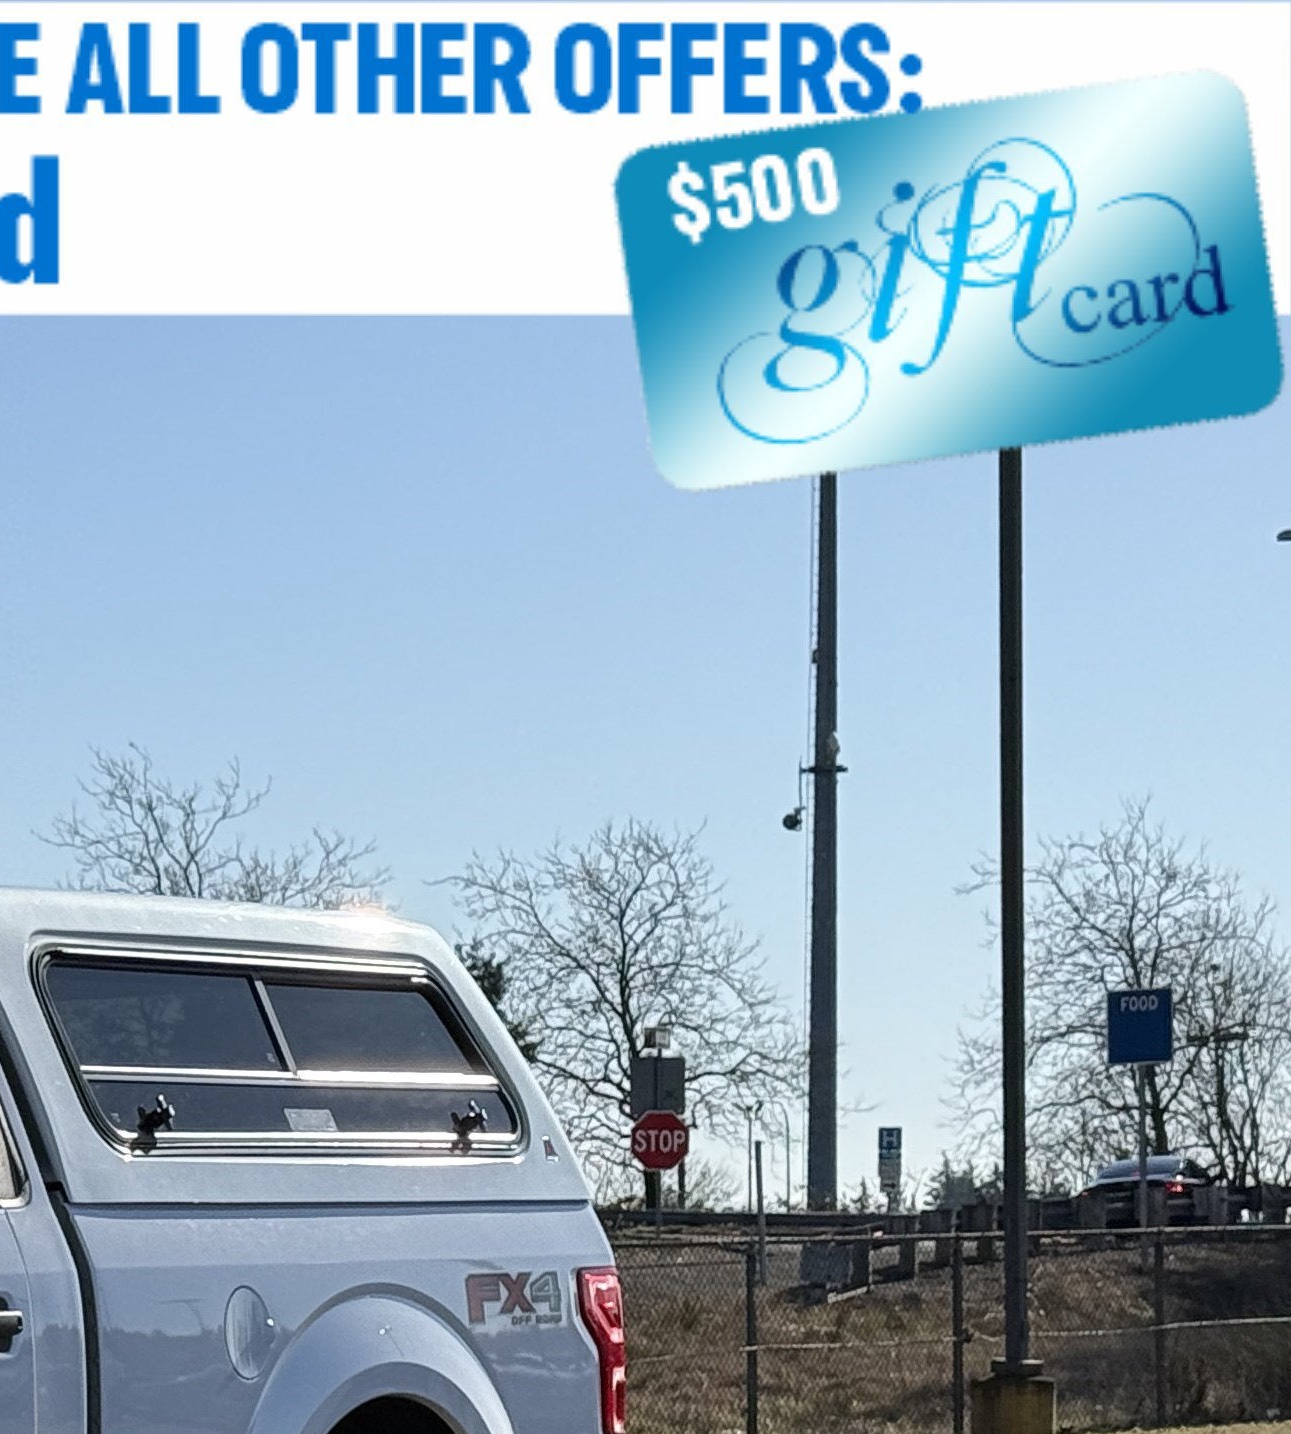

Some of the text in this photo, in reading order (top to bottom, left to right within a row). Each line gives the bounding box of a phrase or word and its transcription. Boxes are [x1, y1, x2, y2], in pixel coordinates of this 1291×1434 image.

[1120, 994, 1159, 1012] FOOD
[634, 1129, 686, 1154] STOP
[882, 1130, 898, 1148] H
[465, 1271, 562, 1325] FX4
[511, 1314, 532, 1326] OFF
